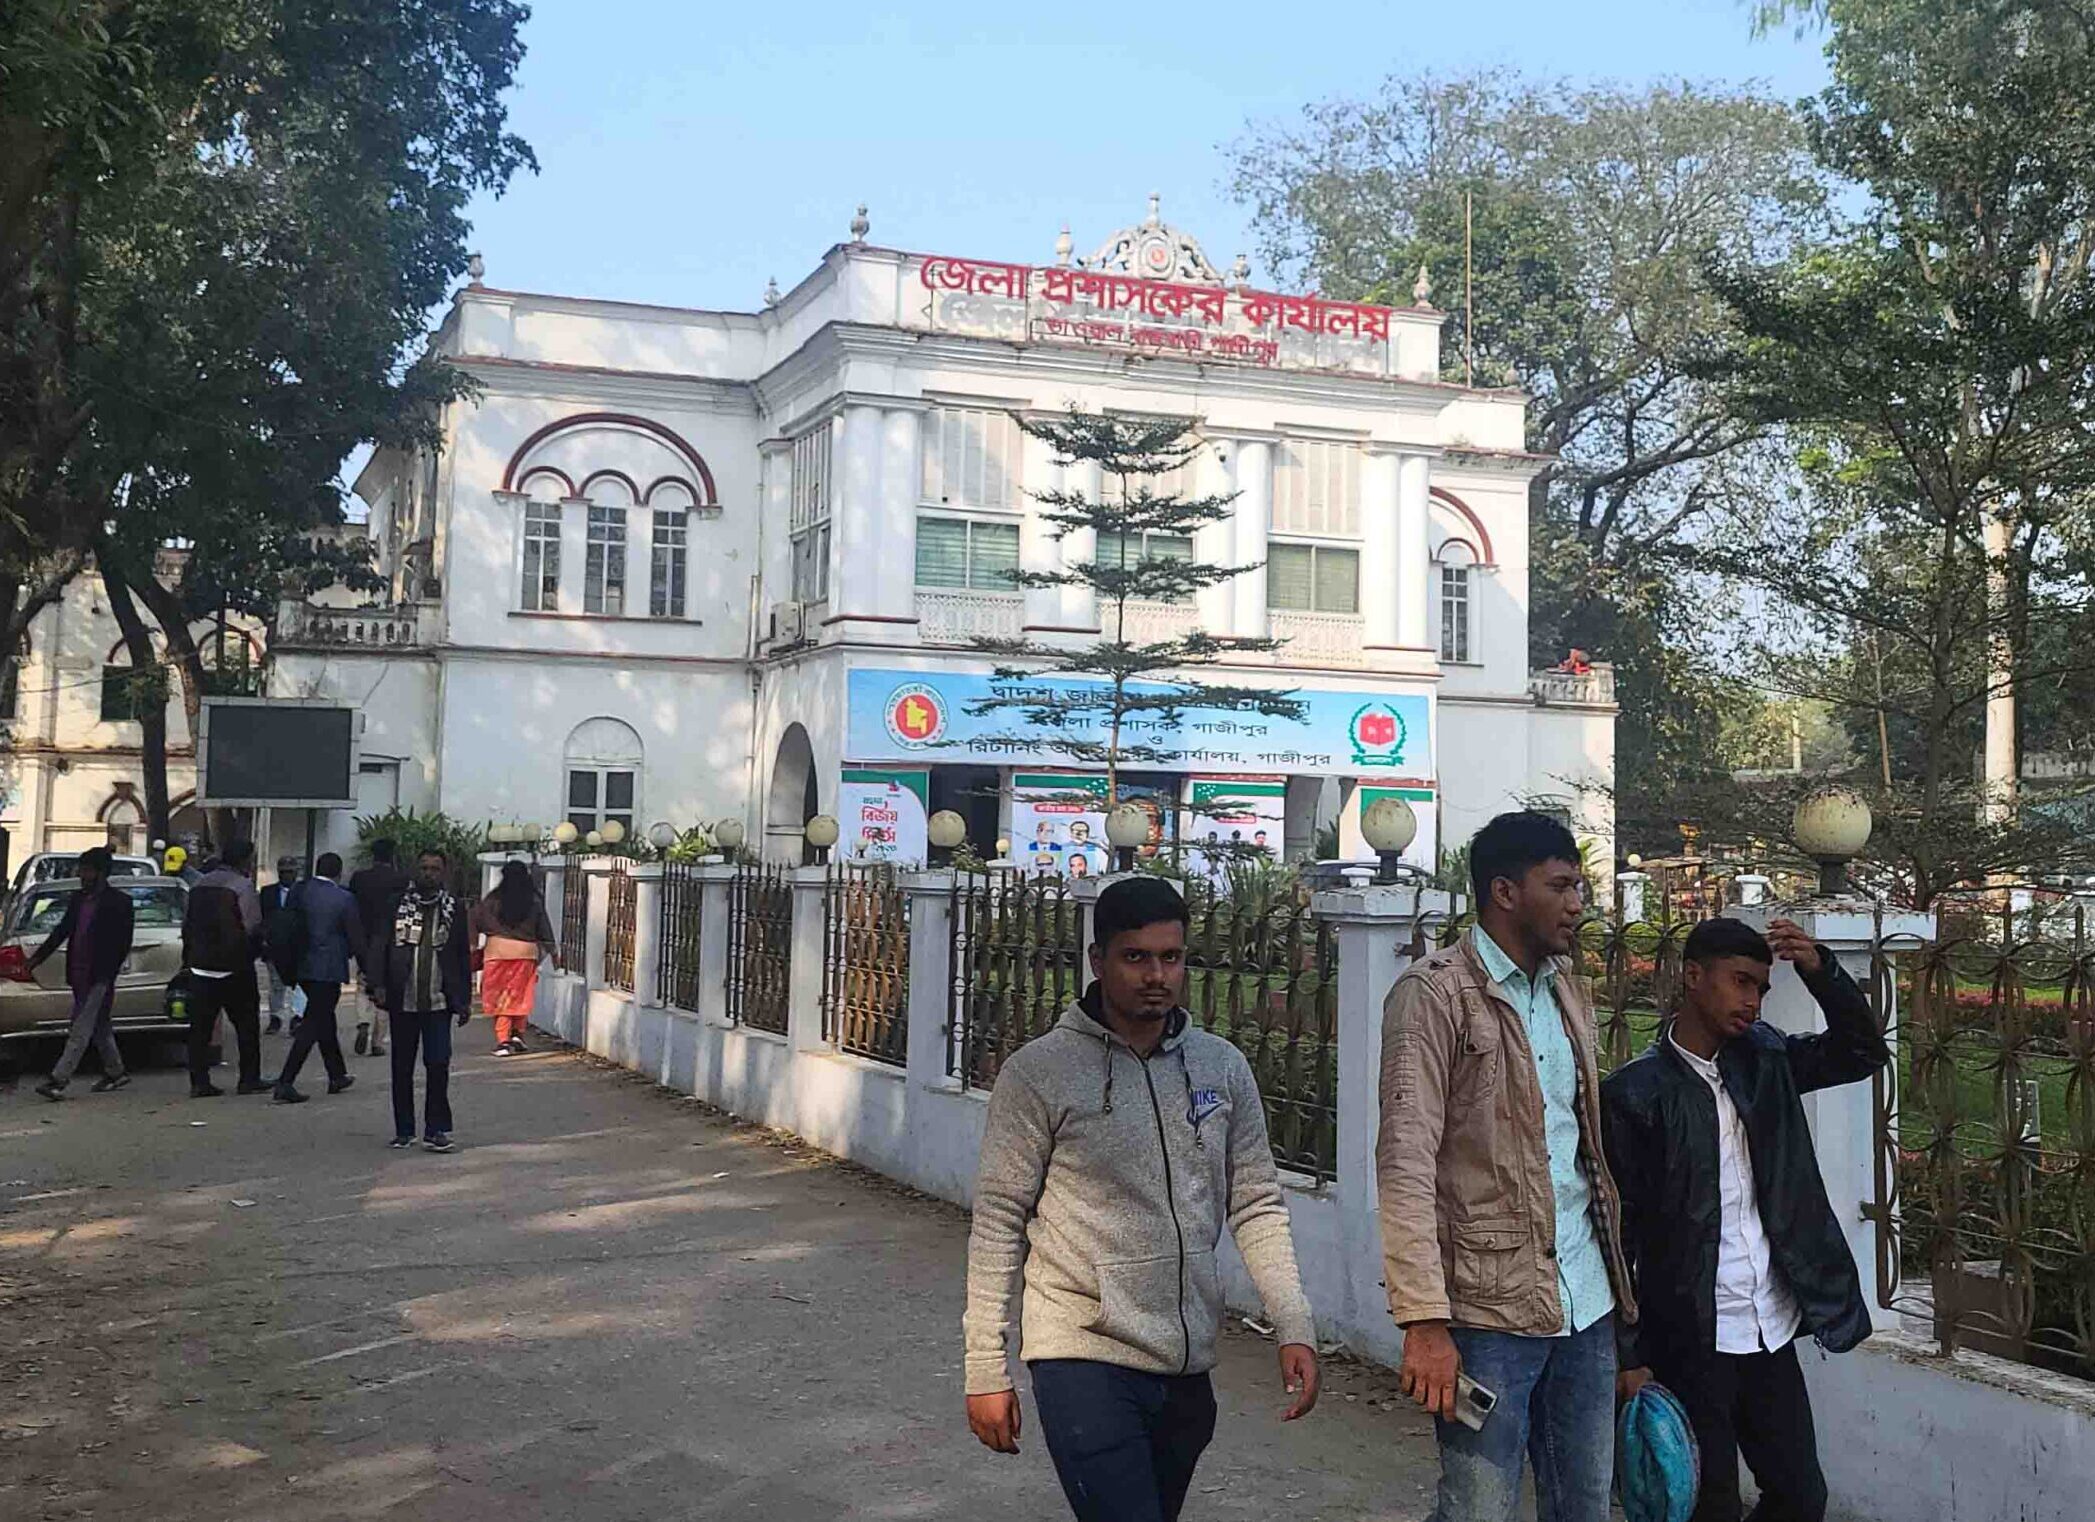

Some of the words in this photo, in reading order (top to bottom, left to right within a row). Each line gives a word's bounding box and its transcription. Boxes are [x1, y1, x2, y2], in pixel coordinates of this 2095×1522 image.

[920, 255, 1027, 300] জেলা
[1041, 268, 1229, 327] প্রশাসকের
[1241, 290, 1392, 345] কার্যালয়
[1192, 717, 1268, 737] গাজীপুর
[1146, 736, 1164, 745] ও
[1256, 746, 1332, 767] গাজীপুর
